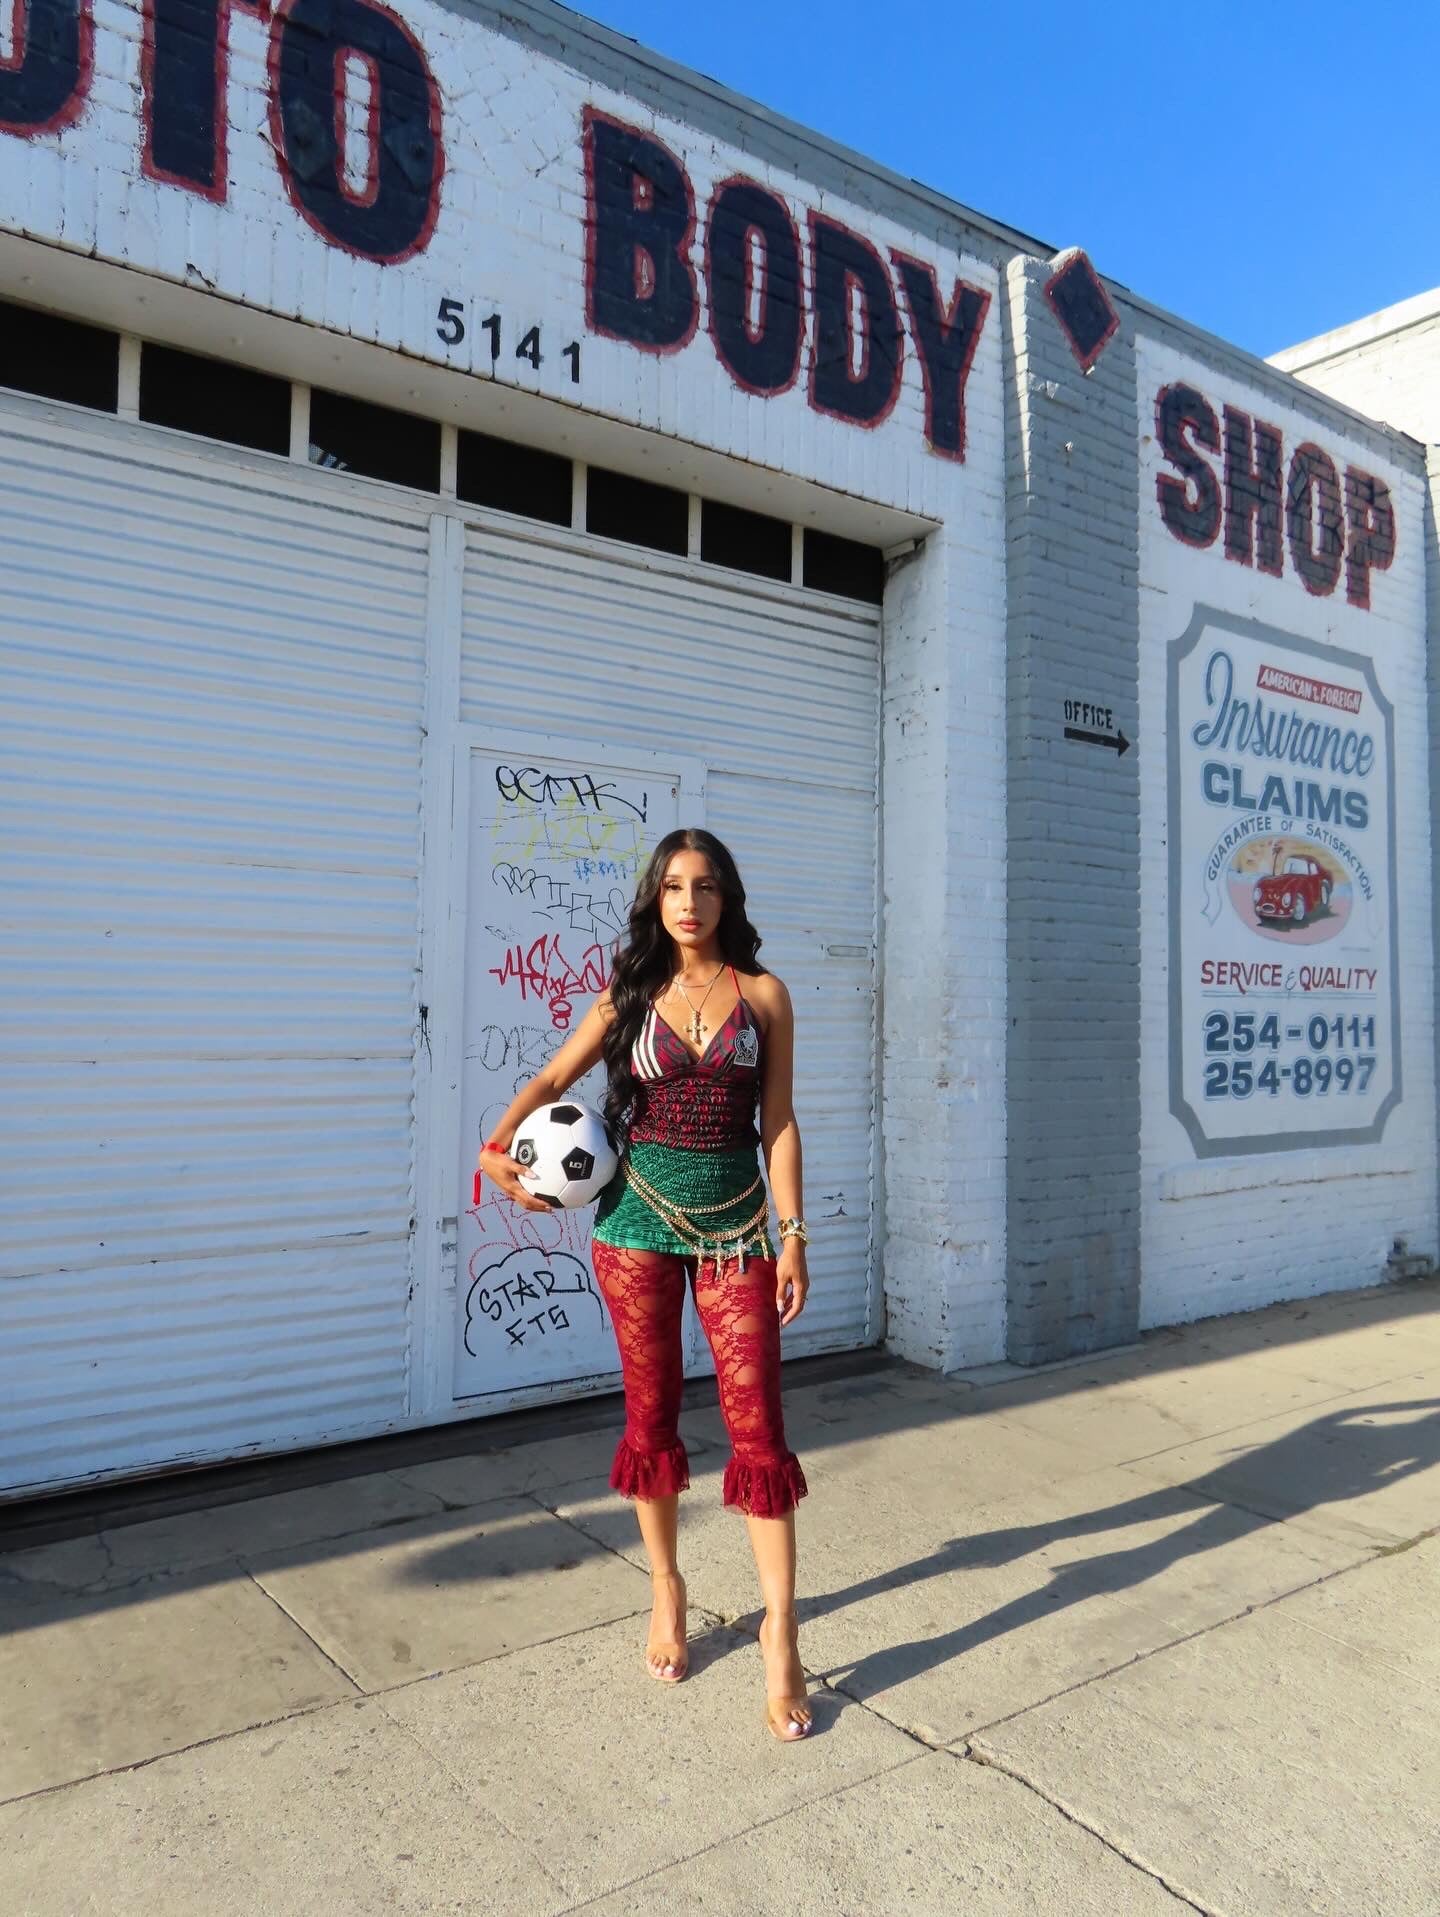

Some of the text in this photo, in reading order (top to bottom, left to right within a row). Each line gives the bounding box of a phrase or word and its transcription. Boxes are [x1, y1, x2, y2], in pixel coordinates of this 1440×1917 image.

[437, 297, 581, 384] 5141
[582, 103, 992, 464] BODY
[1154, 382, 1397, 612] SHOP
[1064, 699, 1113, 729] OFFICE
[1192, 650, 1375, 778] Insurance
[1260, 668, 1313, 699] AMERICAN
[1320, 686, 1361, 711] FOREIGN
[1202, 761, 1371, 830] CLAIMS
[1207, 816, 1272, 881] GUARANTEE
[1306, 823, 1373, 901] SATISFACTION
[1200, 959, 1283, 995] SERVICE
[1299, 965, 1378, 991] QUALITY
[1202, 1010, 1376, 1055] 254-0111
[1202, 1056, 1376, 1101] 254-8997
